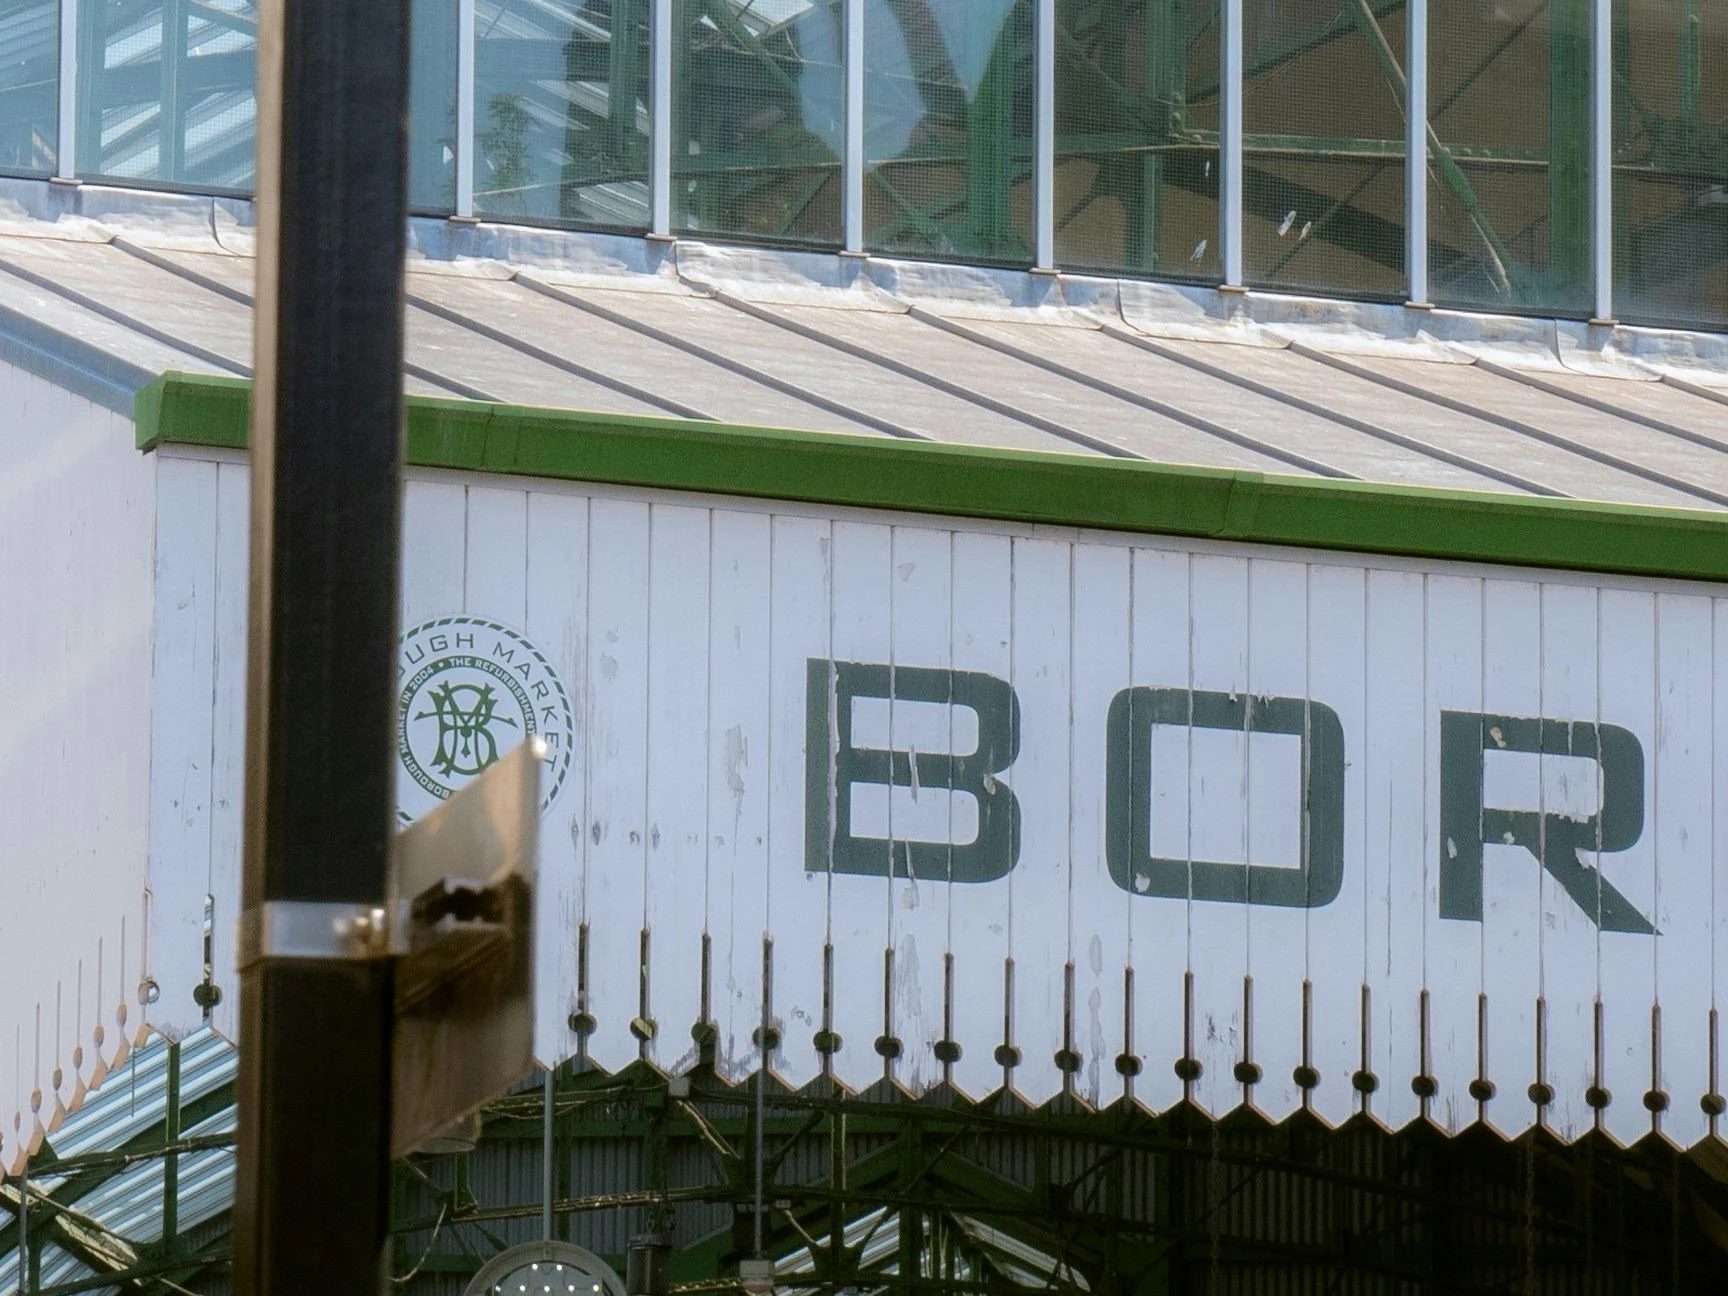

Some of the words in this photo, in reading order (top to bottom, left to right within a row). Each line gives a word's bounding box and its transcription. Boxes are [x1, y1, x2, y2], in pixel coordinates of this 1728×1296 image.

[409, 665, 434, 692] 2004
[448, 656, 472, 667] THE
[474, 657, 536, 735] REFURBISHMENT
[492, 641, 559, 773] MARKET
